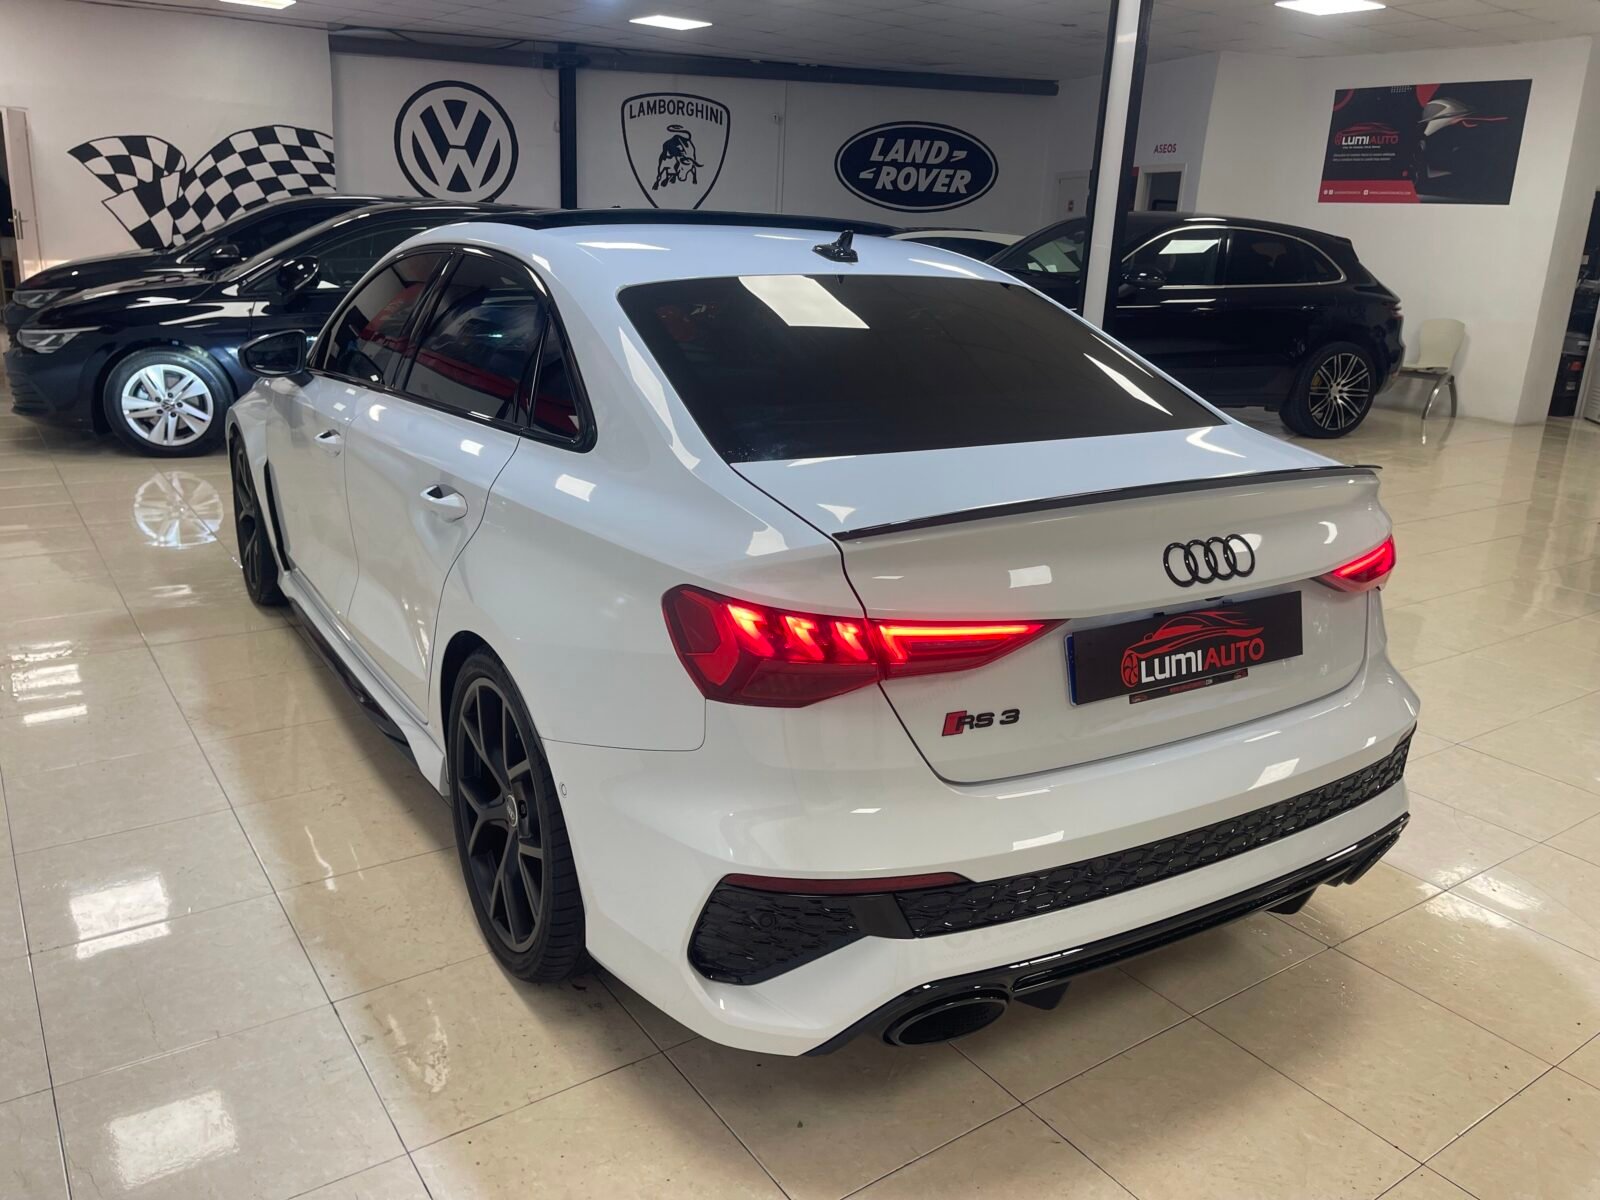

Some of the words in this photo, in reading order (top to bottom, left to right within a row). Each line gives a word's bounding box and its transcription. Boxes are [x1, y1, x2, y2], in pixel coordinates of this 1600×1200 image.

[629, 99, 723, 125] LAMBORGHINI
[870, 138, 950, 164] LAND
[1153, 143, 1177, 154] ASEOS
[875, 166, 972, 194] ROVER
[955, 712, 995, 730] RS
[999, 708, 1020, 725] 3
